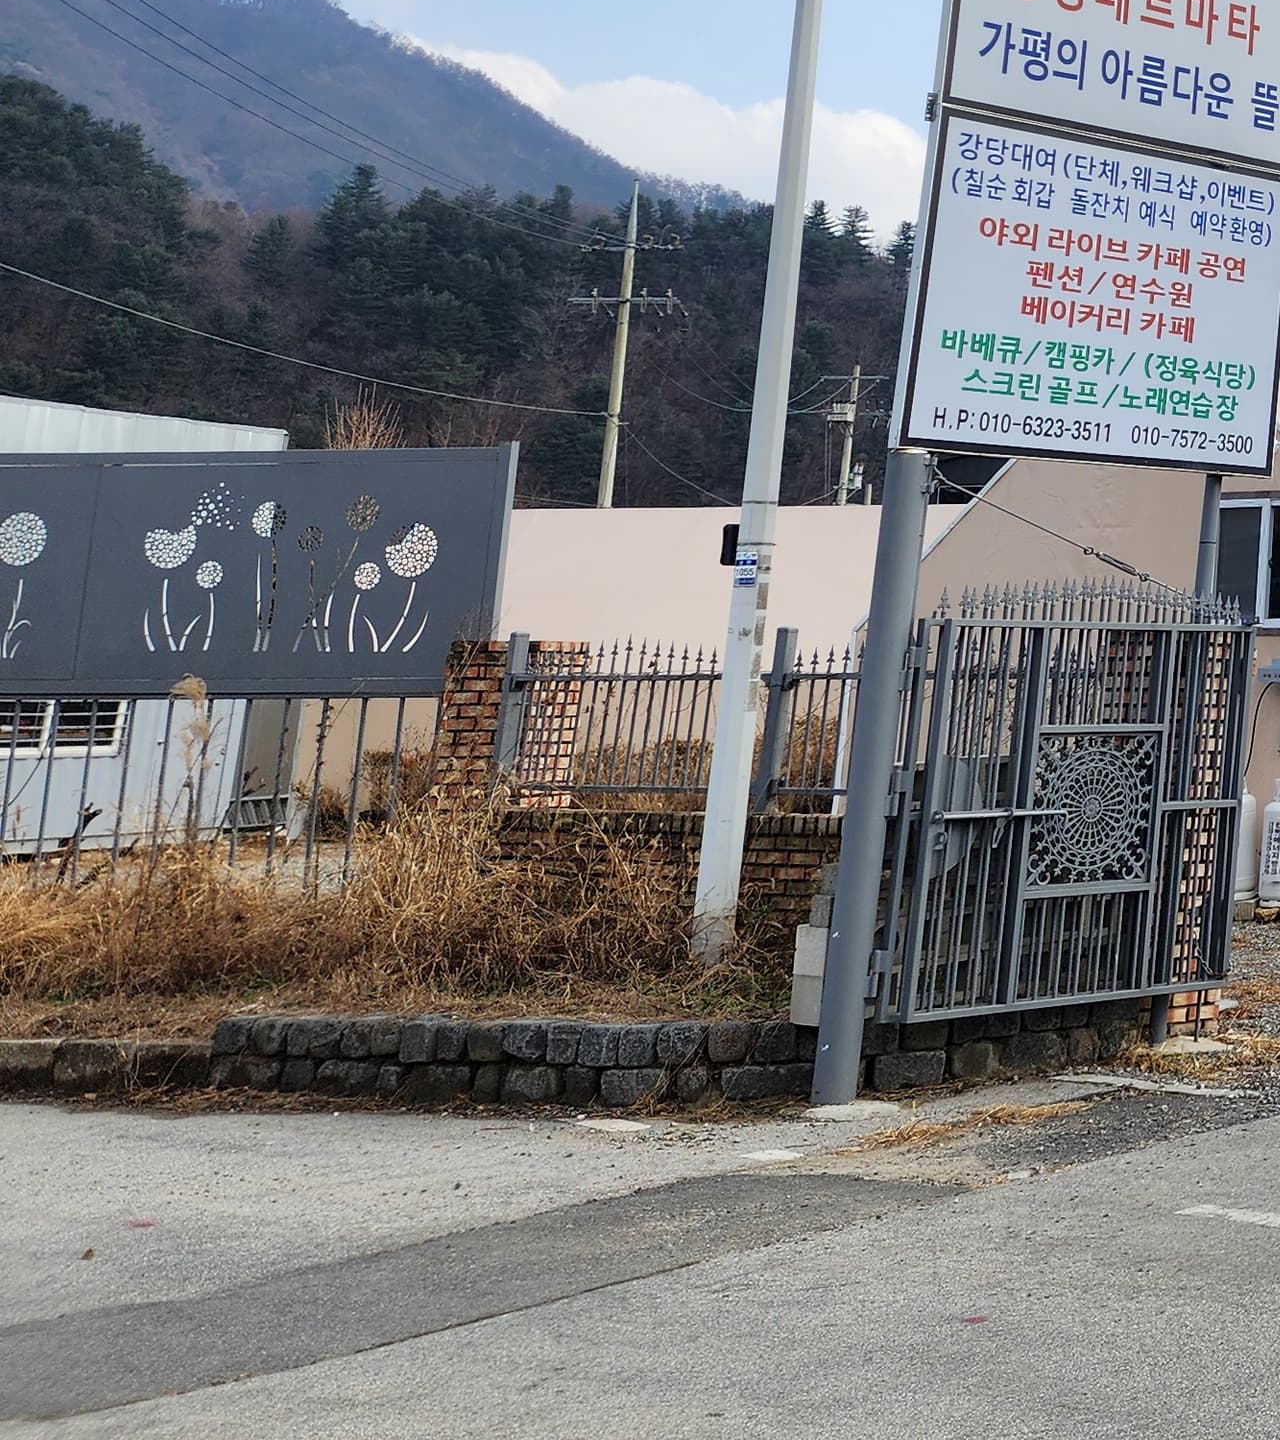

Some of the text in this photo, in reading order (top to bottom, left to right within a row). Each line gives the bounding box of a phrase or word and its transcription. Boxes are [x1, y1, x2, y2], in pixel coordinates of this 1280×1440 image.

[978, 20, 1280, 131] 가평의 아름다운 뜰
[958, 132, 1057, 176] 강당대여
[1011, 176, 1055, 210] 회갑
[1070, 187, 1130, 223] 돌잔치
[1139, 200, 1176, 231] 예식
[979, 217, 1246, 283] 야외 라이브 카페 공연
[1020, 295, 1195, 344] 베이커리 카페
[1130, 425, 1253, 454] 010-7572-3500
